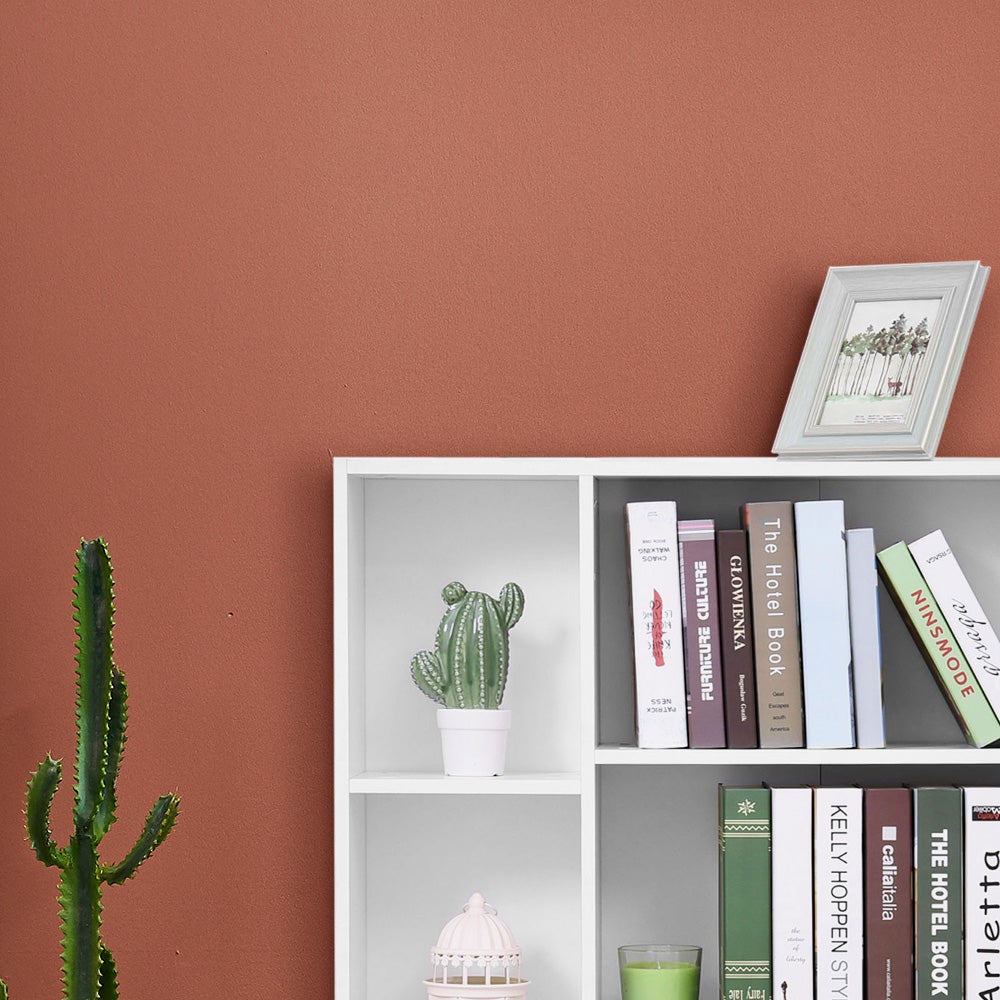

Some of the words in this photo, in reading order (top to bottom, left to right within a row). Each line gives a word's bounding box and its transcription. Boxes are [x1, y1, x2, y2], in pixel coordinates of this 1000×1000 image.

[764, 518, 781, 554] The
[694, 561, 710, 620] CULTURE
[765, 564, 784, 617] Hotel
[767, 627, 786, 676] Book
[911, 589, 975, 698] NINSMODE
[830, 804, 848, 864] KELLY
[930, 829, 948, 868] THE
[830, 871, 848, 953] HOPPEN
[881, 845, 898, 921] caliaitalia
[930, 873, 948, 936] HOTEL
[930, 941, 948, 996] BOOK
